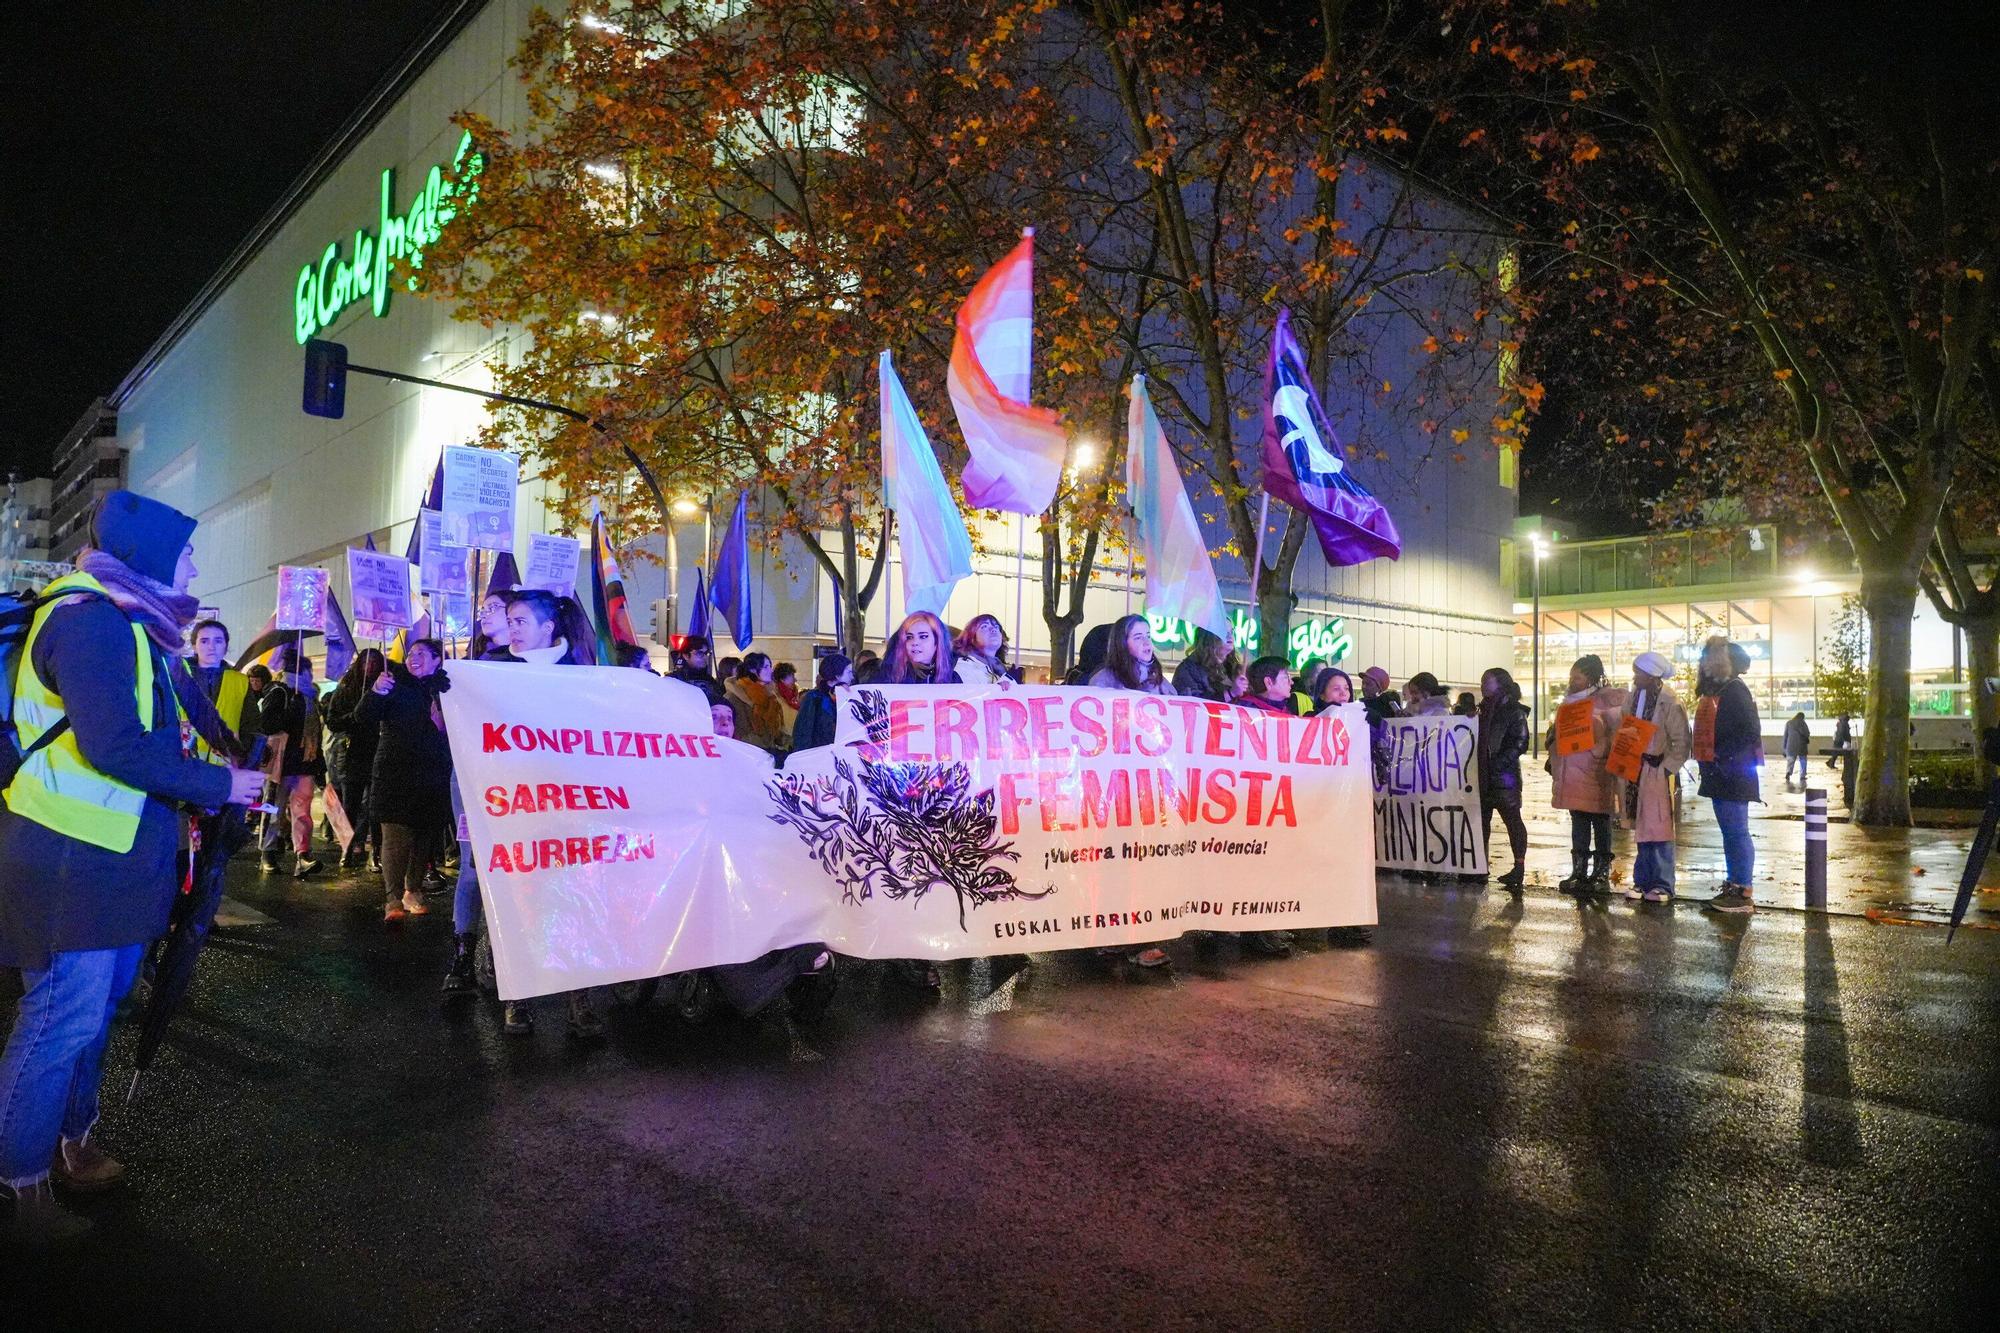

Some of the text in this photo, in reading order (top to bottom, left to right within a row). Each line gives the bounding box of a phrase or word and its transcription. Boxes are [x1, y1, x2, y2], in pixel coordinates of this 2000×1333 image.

[480, 457, 492, 468] NO
[479, 496, 510, 508] MACHISTA
[482, 722, 722, 759] KONPLIZITATE
[890, 696, 1350, 766] ERRESISTENTZIA
[484, 783, 631, 817] SAREEN
[999, 768, 1298, 835] FEMINISTA
[488, 832, 656, 873] AURREAN
[1201, 837, 1268, 856] violencia!
[994, 918, 1062, 939] EUSKAL
[1071, 910, 1153, 931] HERRIKO
[1231, 900, 1301, 917] FEMINISTA
